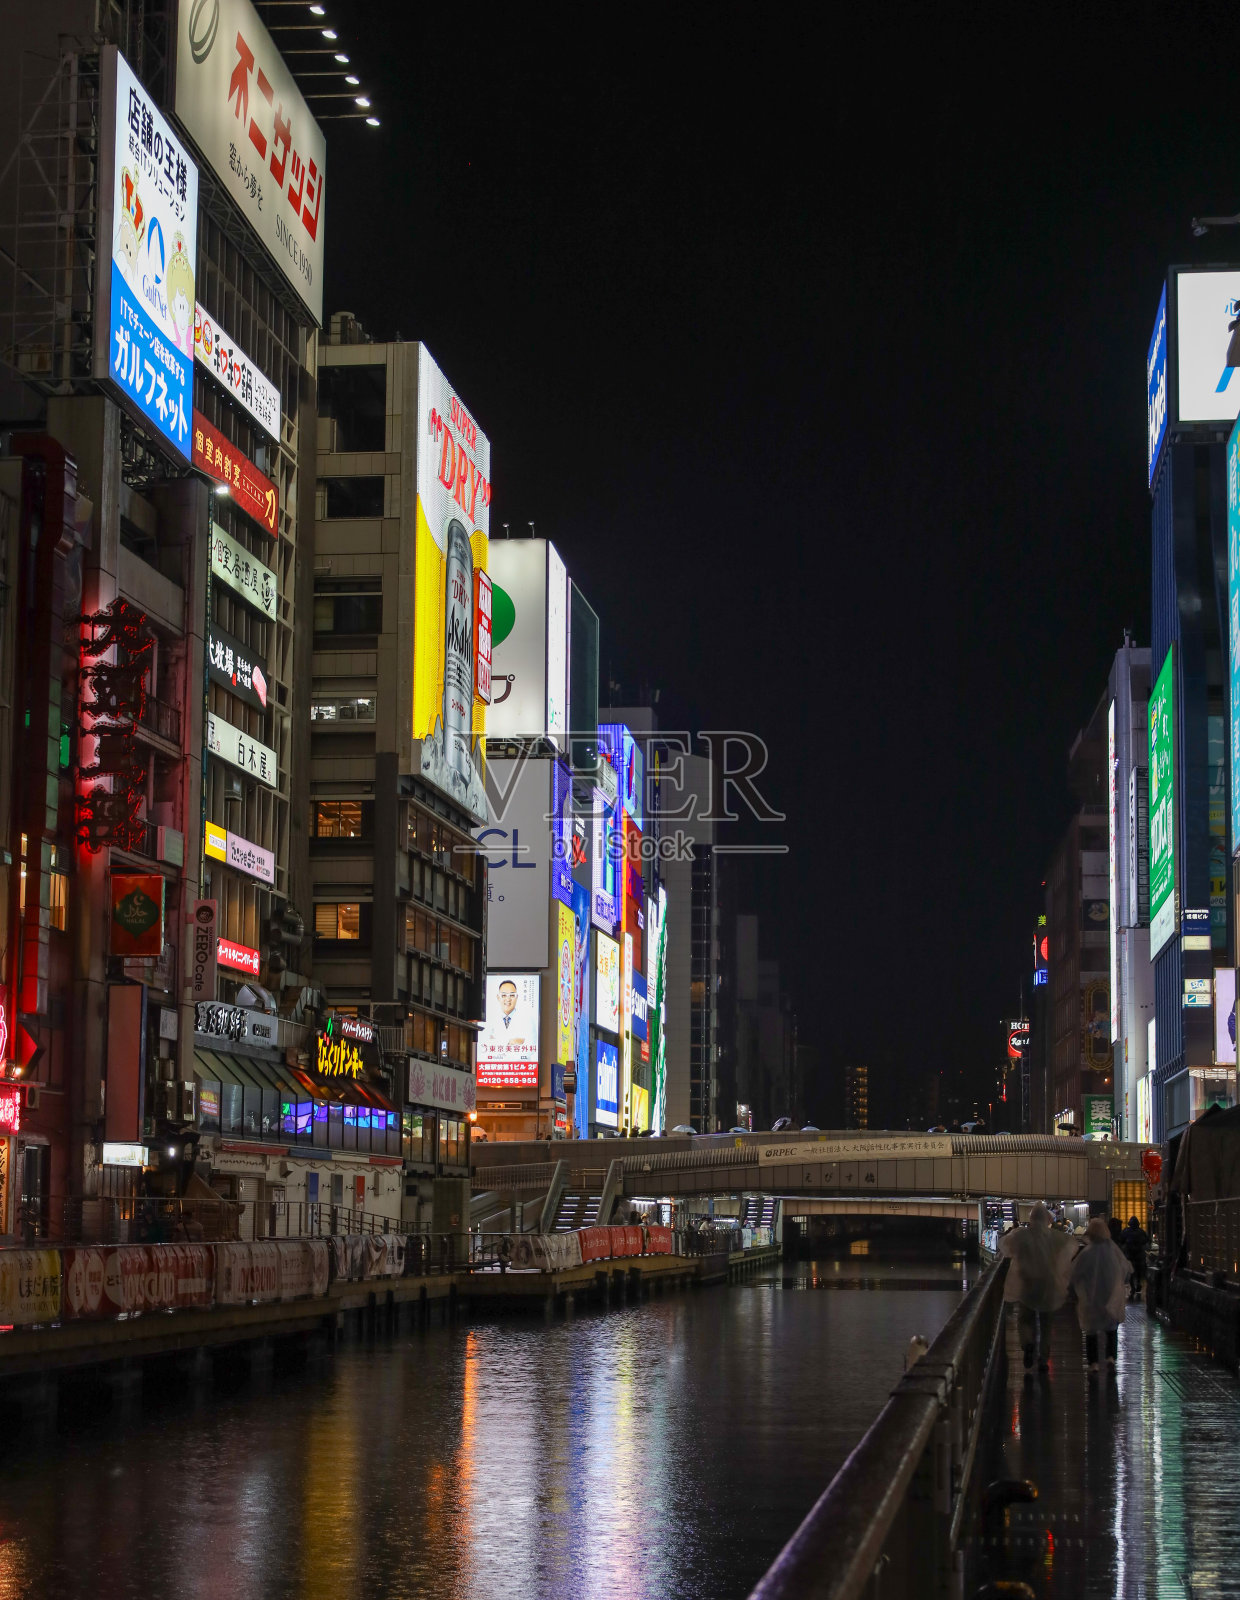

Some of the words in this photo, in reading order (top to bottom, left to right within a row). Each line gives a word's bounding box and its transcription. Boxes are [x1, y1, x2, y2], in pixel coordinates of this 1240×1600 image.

[128, 86, 188, 202] 店舗の王様
[228, 142, 263, 211] 窓から夢を
[276, 213, 298, 266] SINCE
[114, 325, 188, 443] ガルフネット
[450, 396, 477, 453] SUPER
[447, 603, 471, 667] Asahi
[238, 735, 268, 780] 白木屋
[317, 1037, 364, 1079] びっくりドンキー
[489, 1044, 537, 1052] 東京美容外科
[1090, 1100, 1112, 1121] 薬
[804, 1171, 876, 1184] えびす橋
